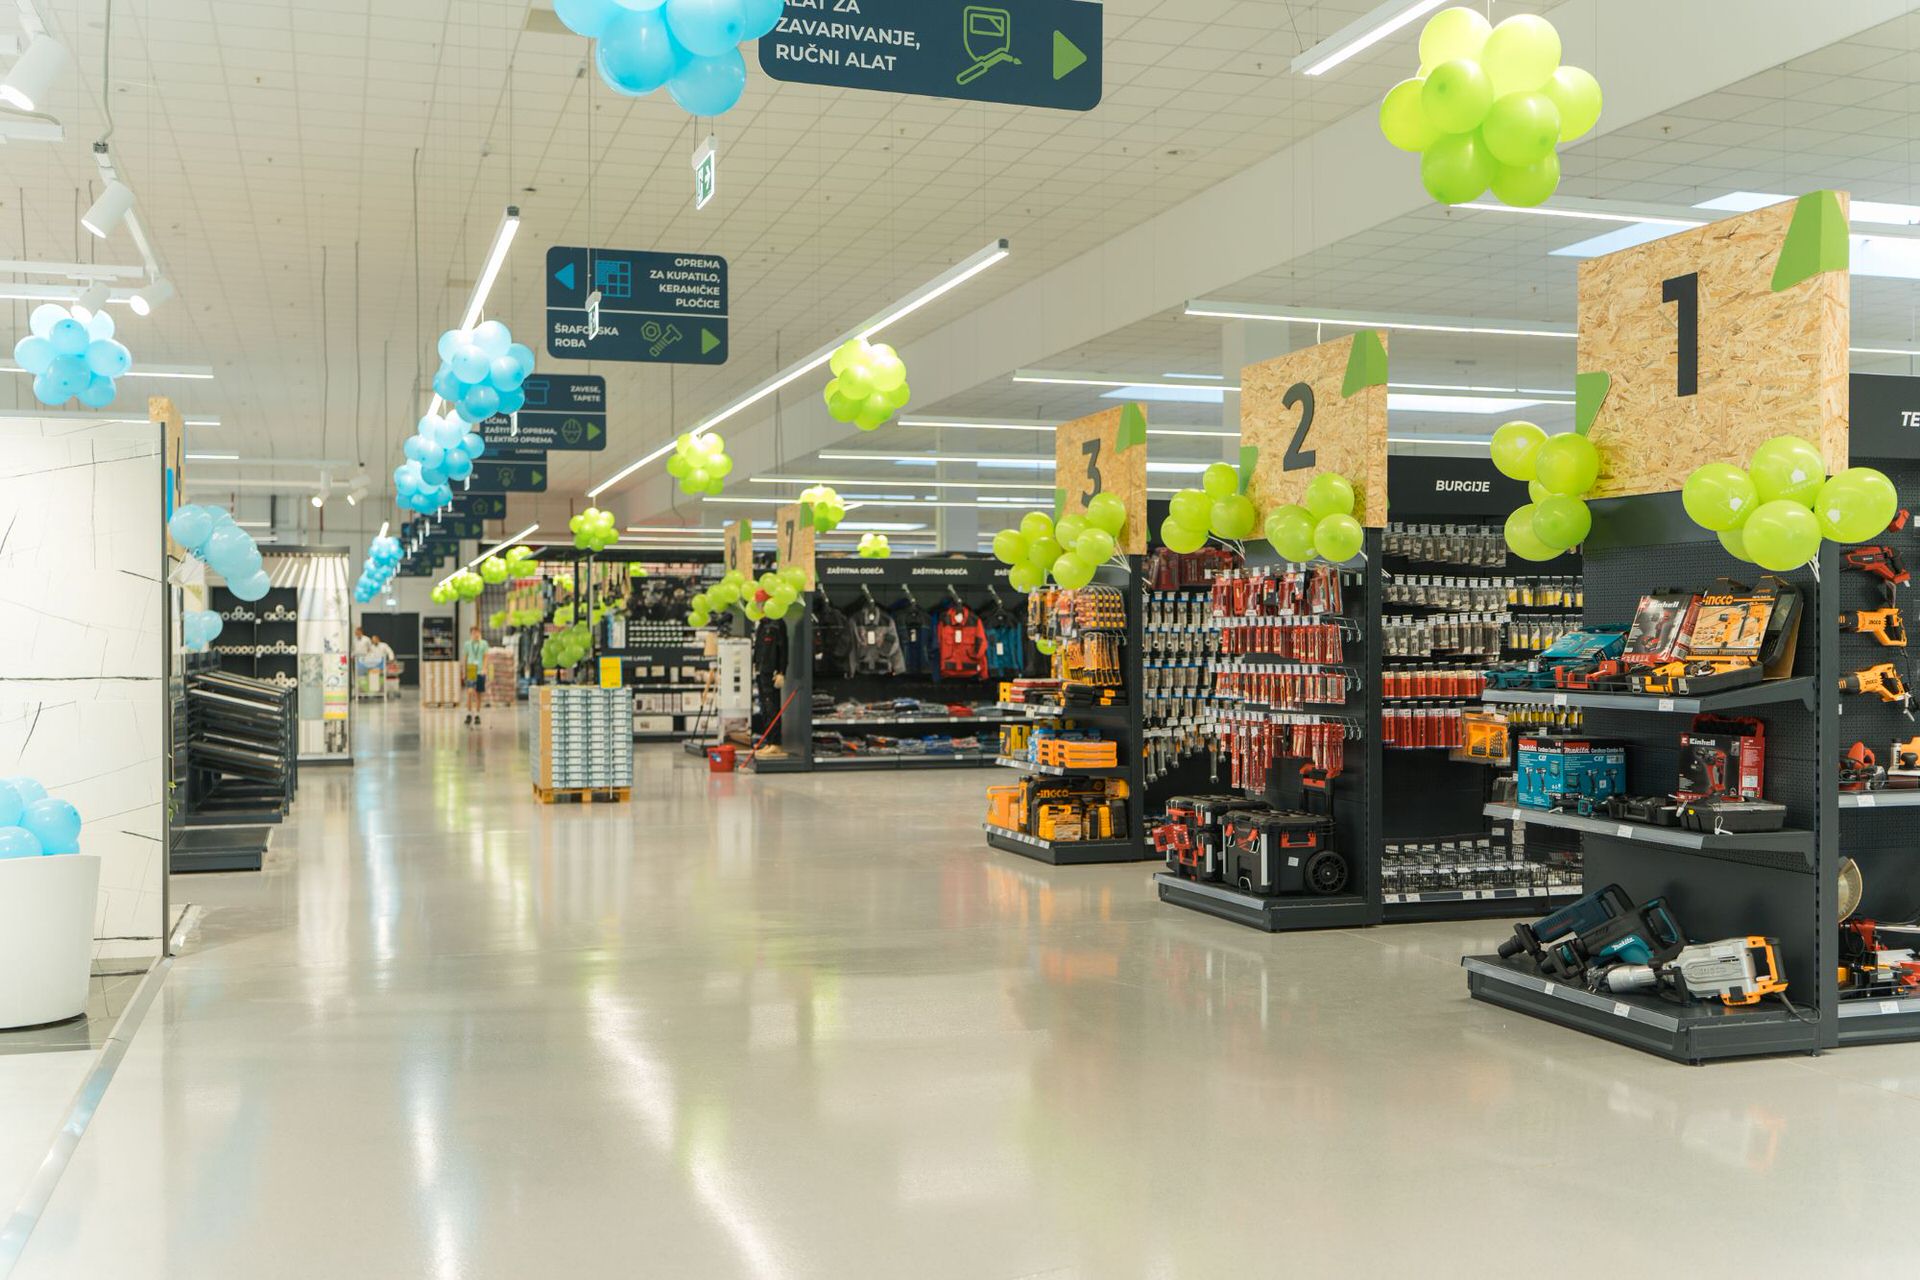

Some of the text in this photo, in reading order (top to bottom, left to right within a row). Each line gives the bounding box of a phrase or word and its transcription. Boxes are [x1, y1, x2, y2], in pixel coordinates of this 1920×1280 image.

[775, 16, 921, 50] ZAVARIVANJE,
[775, 43, 897, 71] RUČNI ALAT
[674, 258, 720, 269] OPREMA
[649, 270, 720, 284] ZA KUPATILO,
[659, 283, 720, 296] KERAMIČKE
[675, 297, 720, 309] PLOČICE
[554, 322, 619, 336] ŠRAFOSKA
[1662, 272, 1698, 397] 1
[555, 338, 587, 348] ROBA
[1282, 382, 1316, 472] 2
[1081, 438, 1102, 508] 3
[1435, 480, 1490, 493] BURGIJE
[826, 566, 859, 574] ZAŠTITNA
[912, 567, 943, 575] ZAŠTITNA
